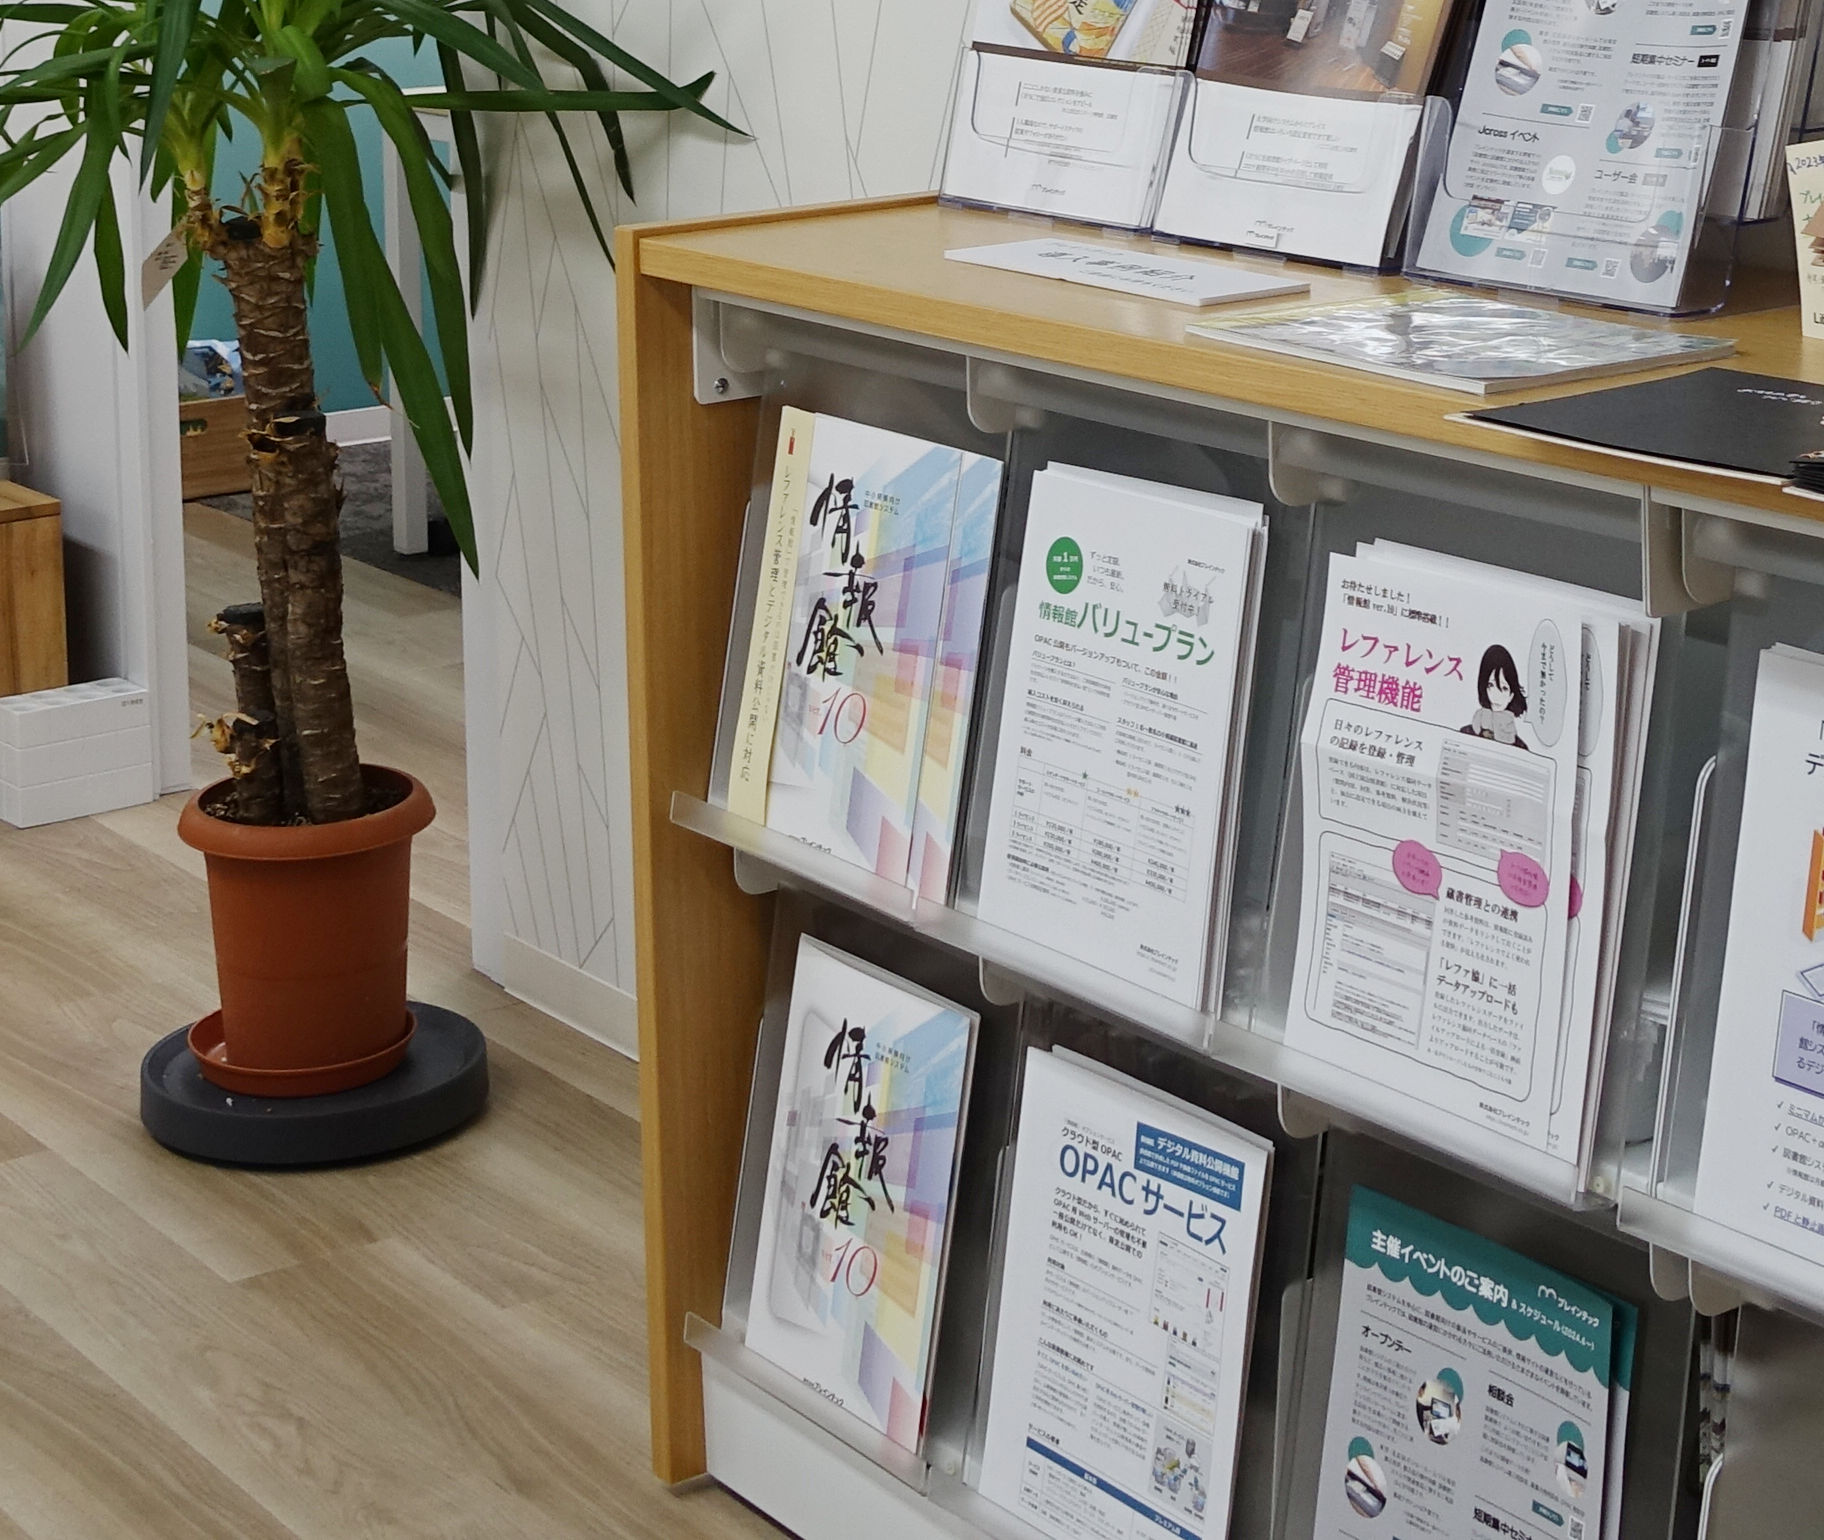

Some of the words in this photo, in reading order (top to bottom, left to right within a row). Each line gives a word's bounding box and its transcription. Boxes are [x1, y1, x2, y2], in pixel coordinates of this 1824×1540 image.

[1630, 53, 1695, 66] 短期集中セミナー
[1478, 125, 1508, 138] Jcross
[1510, 130, 1540, 142] イベント
[1594, 170, 1639, 184] ユーザー会
[1162, 581, 1215, 605] 無料トライアル
[1340, 577, 1412, 605] お待たせしました！
[1038, 599, 1216, 666] 情報館バリュープラン
[1340, 627, 1465, 682] レファレンス
[1332, 661, 1424, 713] 管理機能
[817, 686, 867, 745] 10
[1328, 734, 1417, 768] の記録を登録・管理
[1333, 717, 1424, 751] 日々のレファレンス
[1445, 886, 1519, 923] 蔵書管理との連携
[1437, 956, 1518, 997] 「レファ協」に一括
[1435, 972, 1519, 1016] データアップロードも
[829, 1236, 879, 1298] 10
[1370, 1228, 1510, 1310] 主催イベントのご案内
[1556, 1296, 1601, 1328] ブレインテック
[1360, 1324, 1413, 1355] オープンデー
[1487, 1382, 1516, 1409] 相談会
